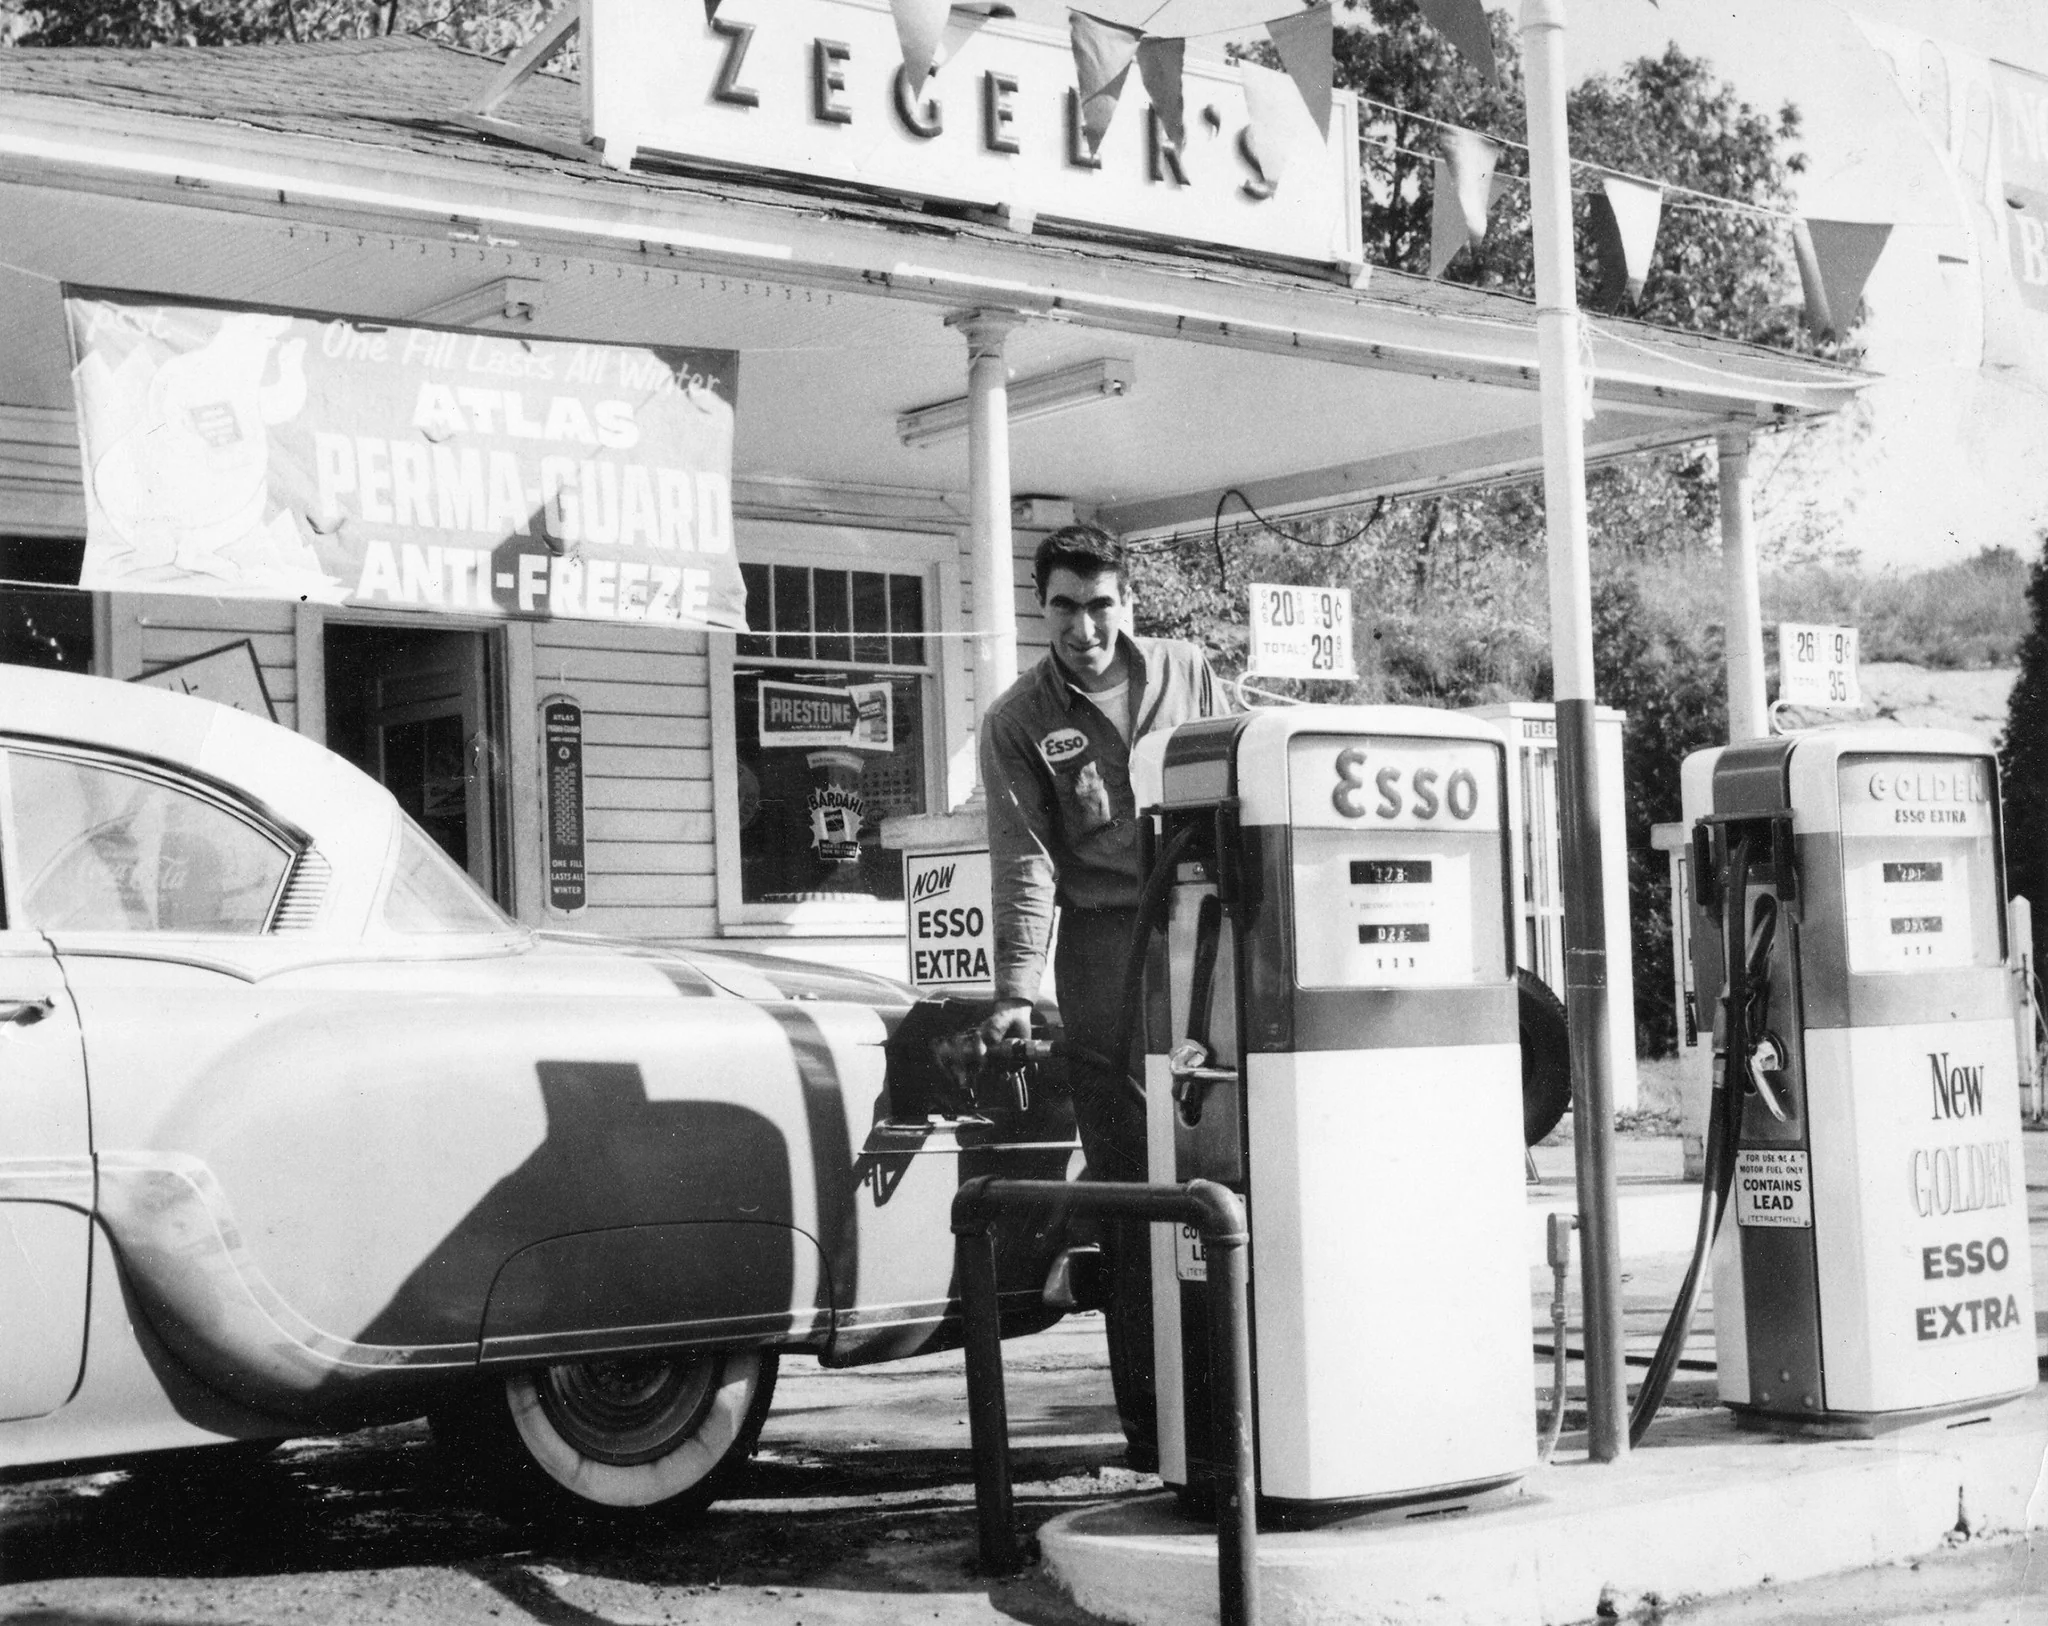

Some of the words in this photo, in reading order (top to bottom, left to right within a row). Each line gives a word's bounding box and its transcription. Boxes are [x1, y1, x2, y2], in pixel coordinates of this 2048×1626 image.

[321, 322, 390, 364] One
[402, 328, 457, 369] Fill
[466, 336, 557, 380] Lasts
[565, 345, 606, 385] All
[619, 350, 721, 395] Winter
[411, 380, 641, 450] ATLAS
[314, 432, 732, 555] PERMA-GUARD
[355, 540, 711, 619] ANTI-FREEZE
[1270, 590, 1295, 627] 20
[1311, 633, 1334, 671] 29
[1797, 632, 1815, 662] 26
[1829, 670, 1847, 701] 35
[770, 698, 851, 724] PRESTONE
[1523, 720, 1557, 738] TELE
[808, 792, 864, 817] BARDAHL
[1895, 809, 1926, 823] ESSO
[1930, 809, 1967, 823] EXTRA
[552, 859, 567, 868] ONE
[553, 886, 582, 894] WINTER
[912, 863, 956, 898] NOW
[918, 906, 984, 939] ESSO
[915, 947, 991, 980] EXTRA
[1926, 1051, 1985, 1120] New
[1739, 1165, 1764, 1174] MOTOR
[1766, 1165, 1783, 1174] FUEL
[1785, 1165, 1804, 1175] ONLY
[1746, 1153, 1760, 1163] FOR
[1762, 1154, 1775, 1163] USE
[1790, 1154, 1796, 1163] A
[1743, 1178, 1802, 1192] CONTAINS
[1909, 1140, 2012, 1218] GOLDEN
[1753, 1194, 1794, 1210] LEAD
[1922, 1236, 2010, 1281] ESSO
[1915, 1293, 2021, 1342] EXTRA
